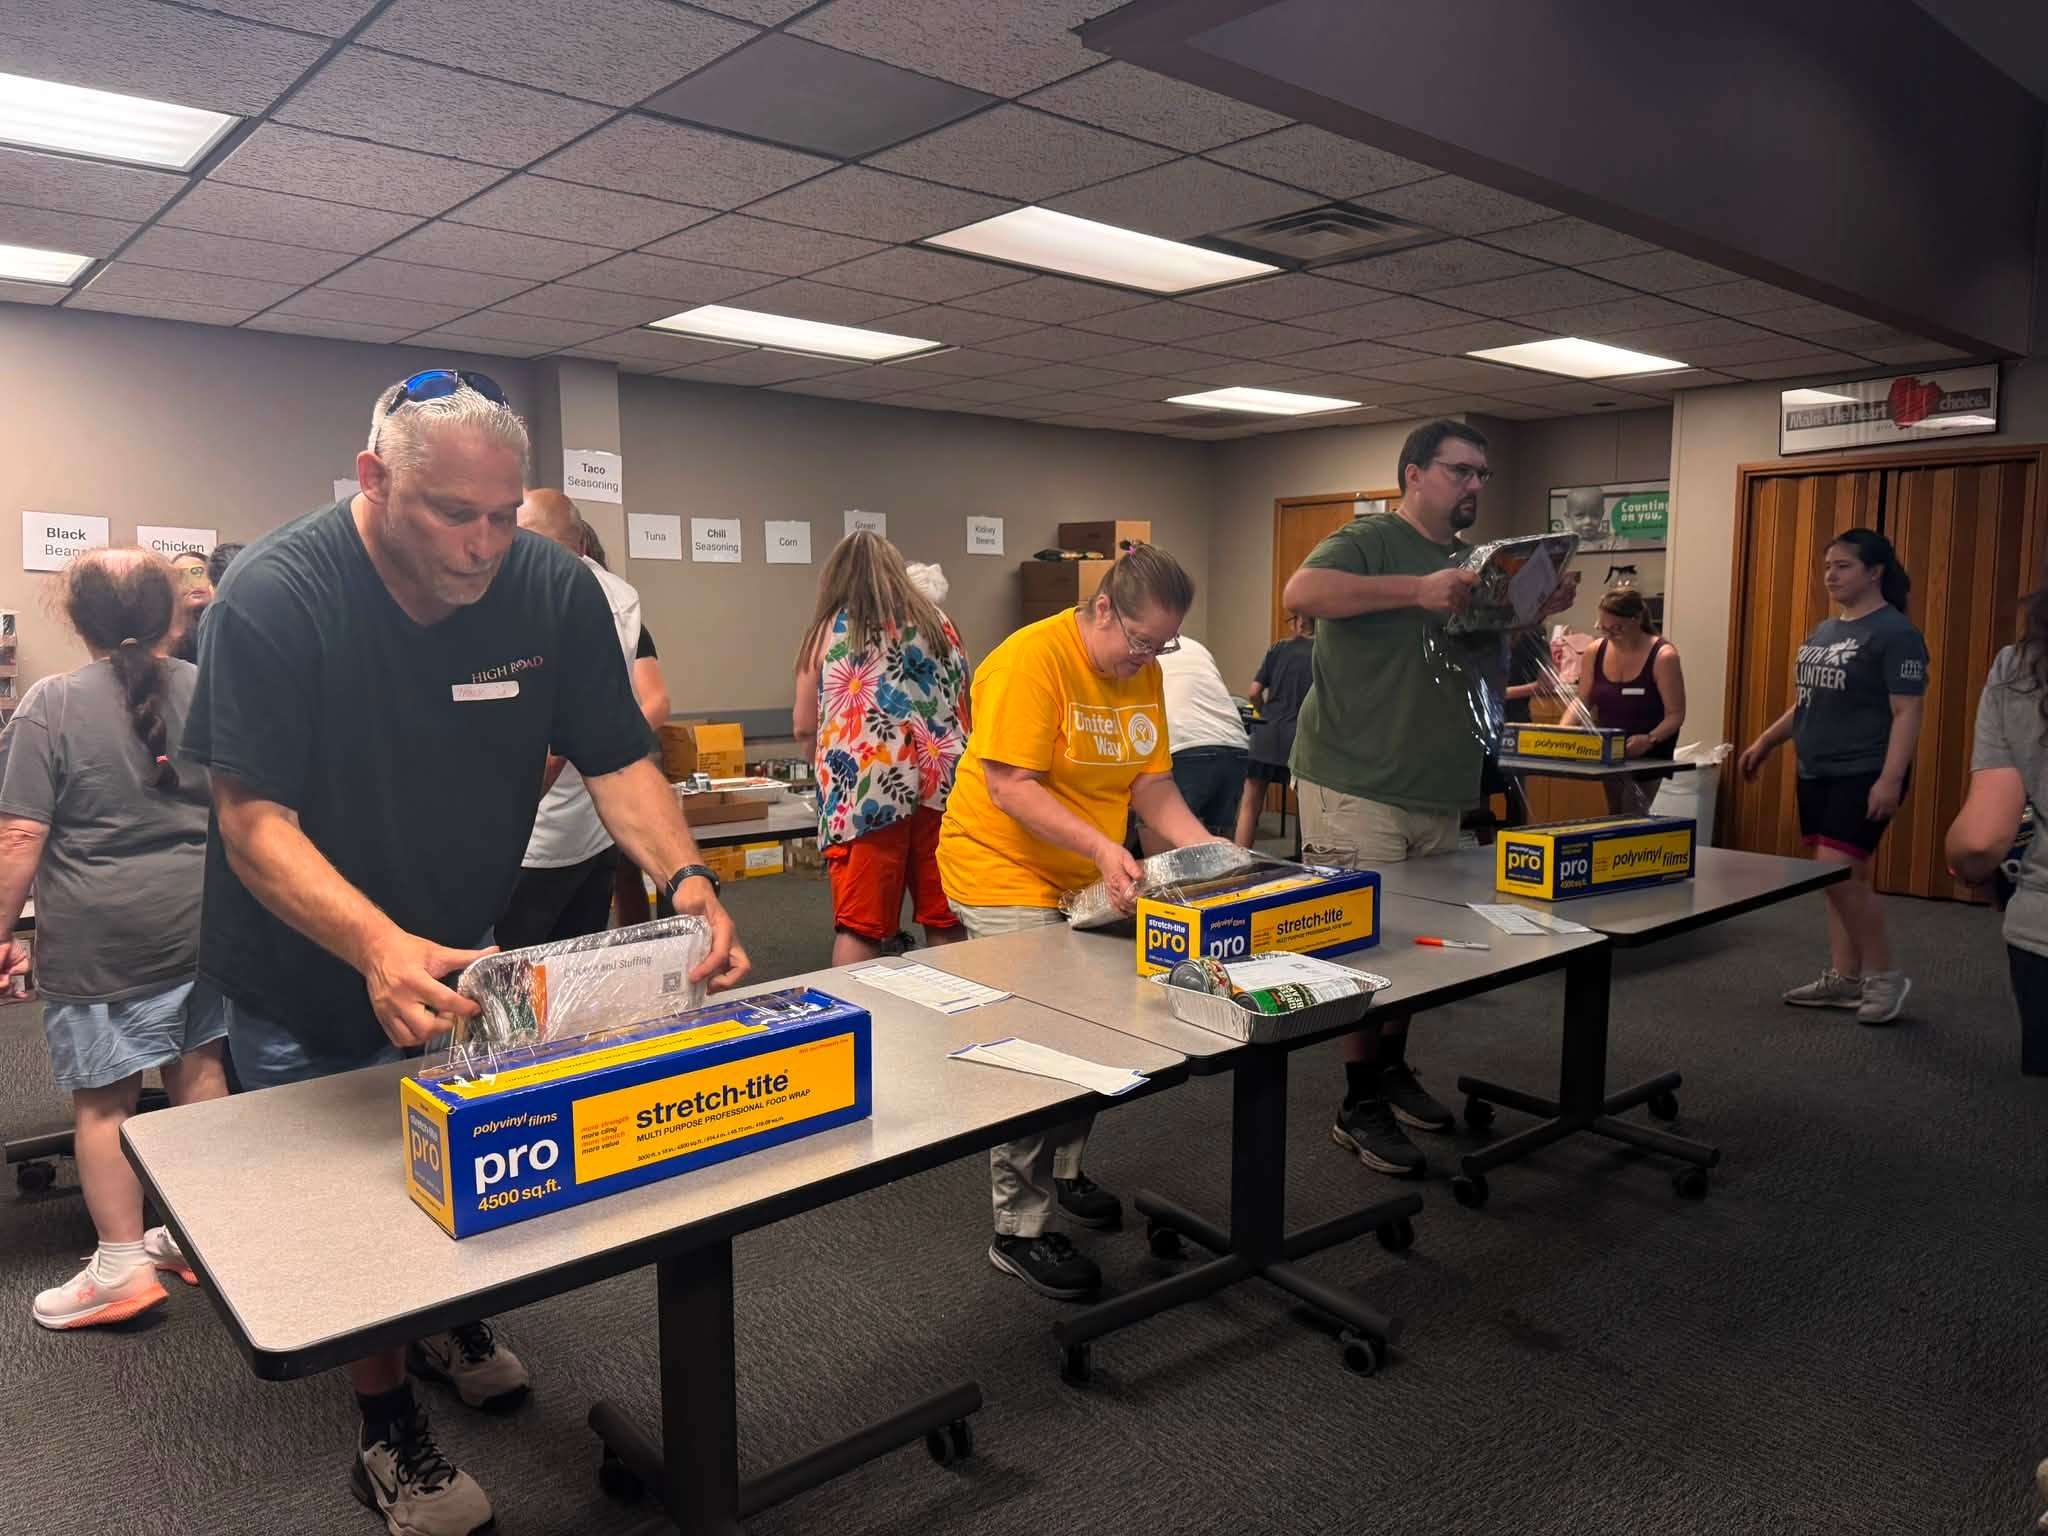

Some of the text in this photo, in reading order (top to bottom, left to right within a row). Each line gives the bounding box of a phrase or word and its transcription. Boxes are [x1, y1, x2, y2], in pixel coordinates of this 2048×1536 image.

[582, 463, 606, 475] Taco
[568, 476, 619, 493] Seasoning
[1621, 511, 1662, 523] on you.
[46, 527, 87, 541] Black
[644, 531, 667, 541] Tuna
[779, 537, 798, 547] Corn
[45, 544, 86, 557] Bean
[152, 540, 205, 553] Chicken
[695, 541, 739, 553] Seasoning
[472, 655, 544, 684] HIGH ROAD
[1093, 735, 1122, 761] Way
[1508, 853, 1541, 871] pro
[1612, 844, 1663, 870] polyvinyl
[1662, 850, 1688, 867] films
[1559, 859, 1588, 880] pro
[1148, 919, 1186, 934] stretch-tite
[1277, 907, 1343, 936] stretch-tite
[1148, 928, 1186, 953] pro
[1210, 935, 1245, 960] pro
[619, 955, 652, 969] Stuffing
[636, 1073, 788, 1129] stretch-tite
[473, 1112, 558, 1137] polyvinyl films
[636, 1088, 811, 1143] MULTI PURPOSE PROFESSIONAL FOOD WRAP
[581, 1131, 599, 1140] more
[411, 1128, 440, 1172] pro
[581, 1140, 620, 1156] more value
[474, 1139, 559, 1195] pro
[478, 1178, 562, 1211] 4500 sq.ft.
